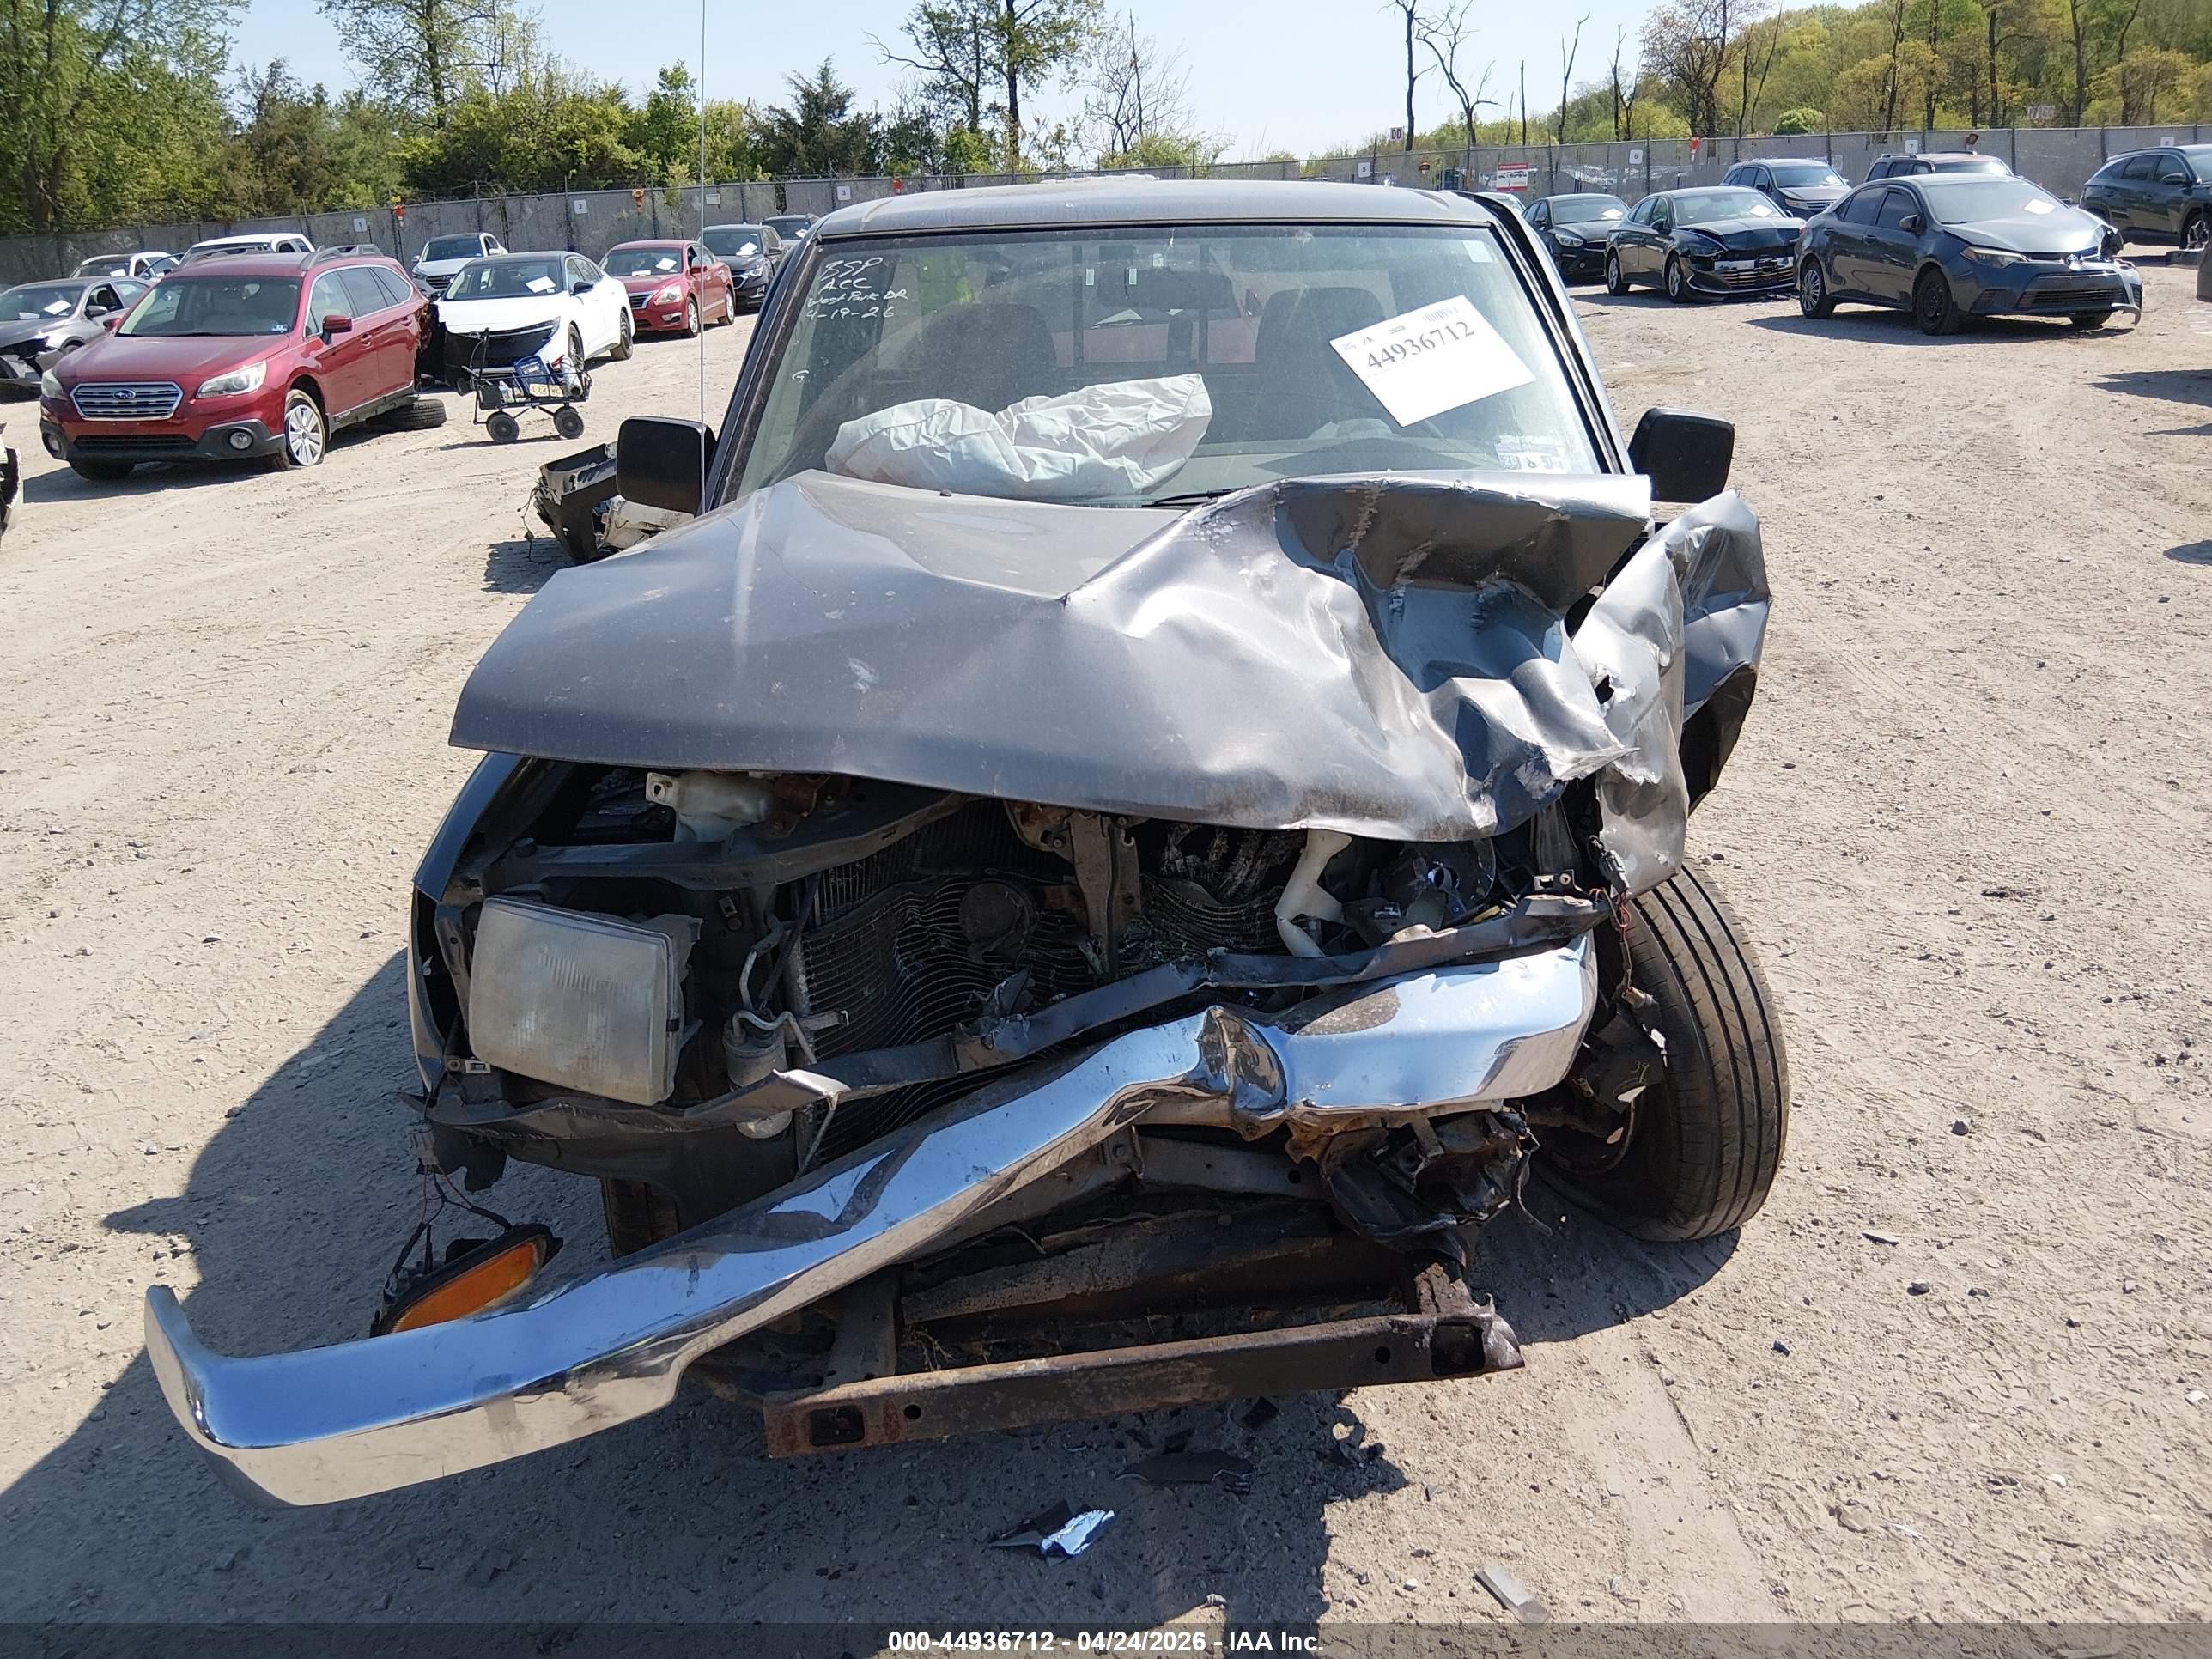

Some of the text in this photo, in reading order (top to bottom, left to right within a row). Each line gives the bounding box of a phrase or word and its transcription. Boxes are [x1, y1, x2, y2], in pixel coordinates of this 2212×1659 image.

[1390, 128, 1402, 140] DD
[817, 277, 873, 295] ACC
[1367, 320, 1475, 368] 44936712
